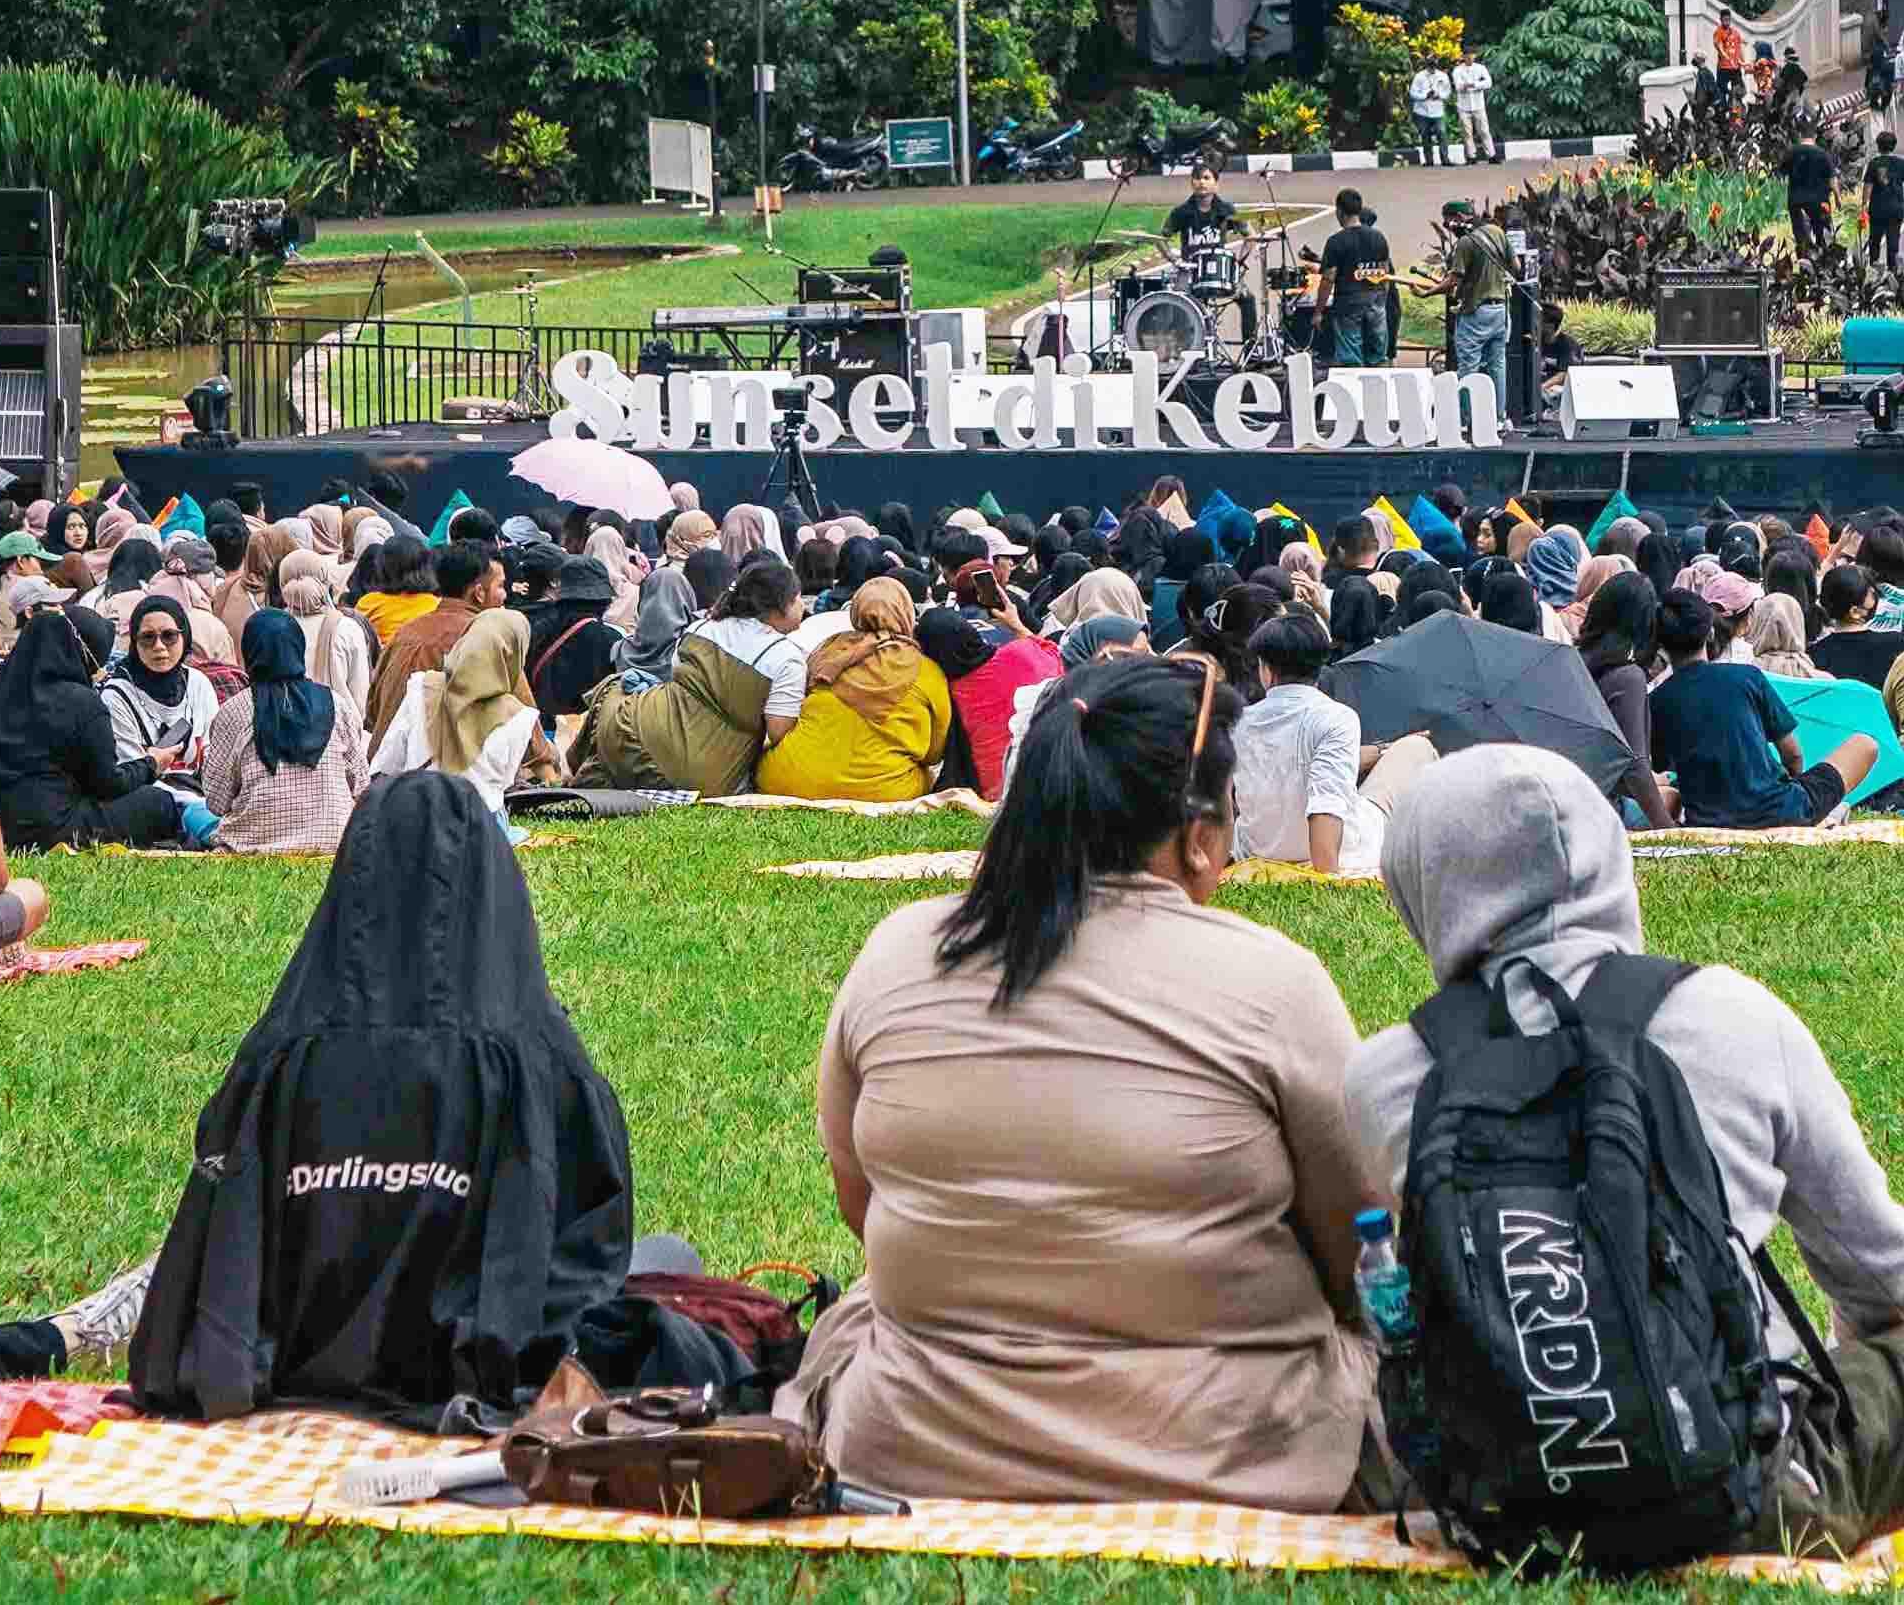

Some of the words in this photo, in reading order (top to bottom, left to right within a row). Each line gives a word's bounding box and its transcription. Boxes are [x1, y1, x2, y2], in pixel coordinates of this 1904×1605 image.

[548, 342, 966, 451] Sunset
[994, 352, 1107, 450] di
[1127, 350, 1503, 450] Kebun
